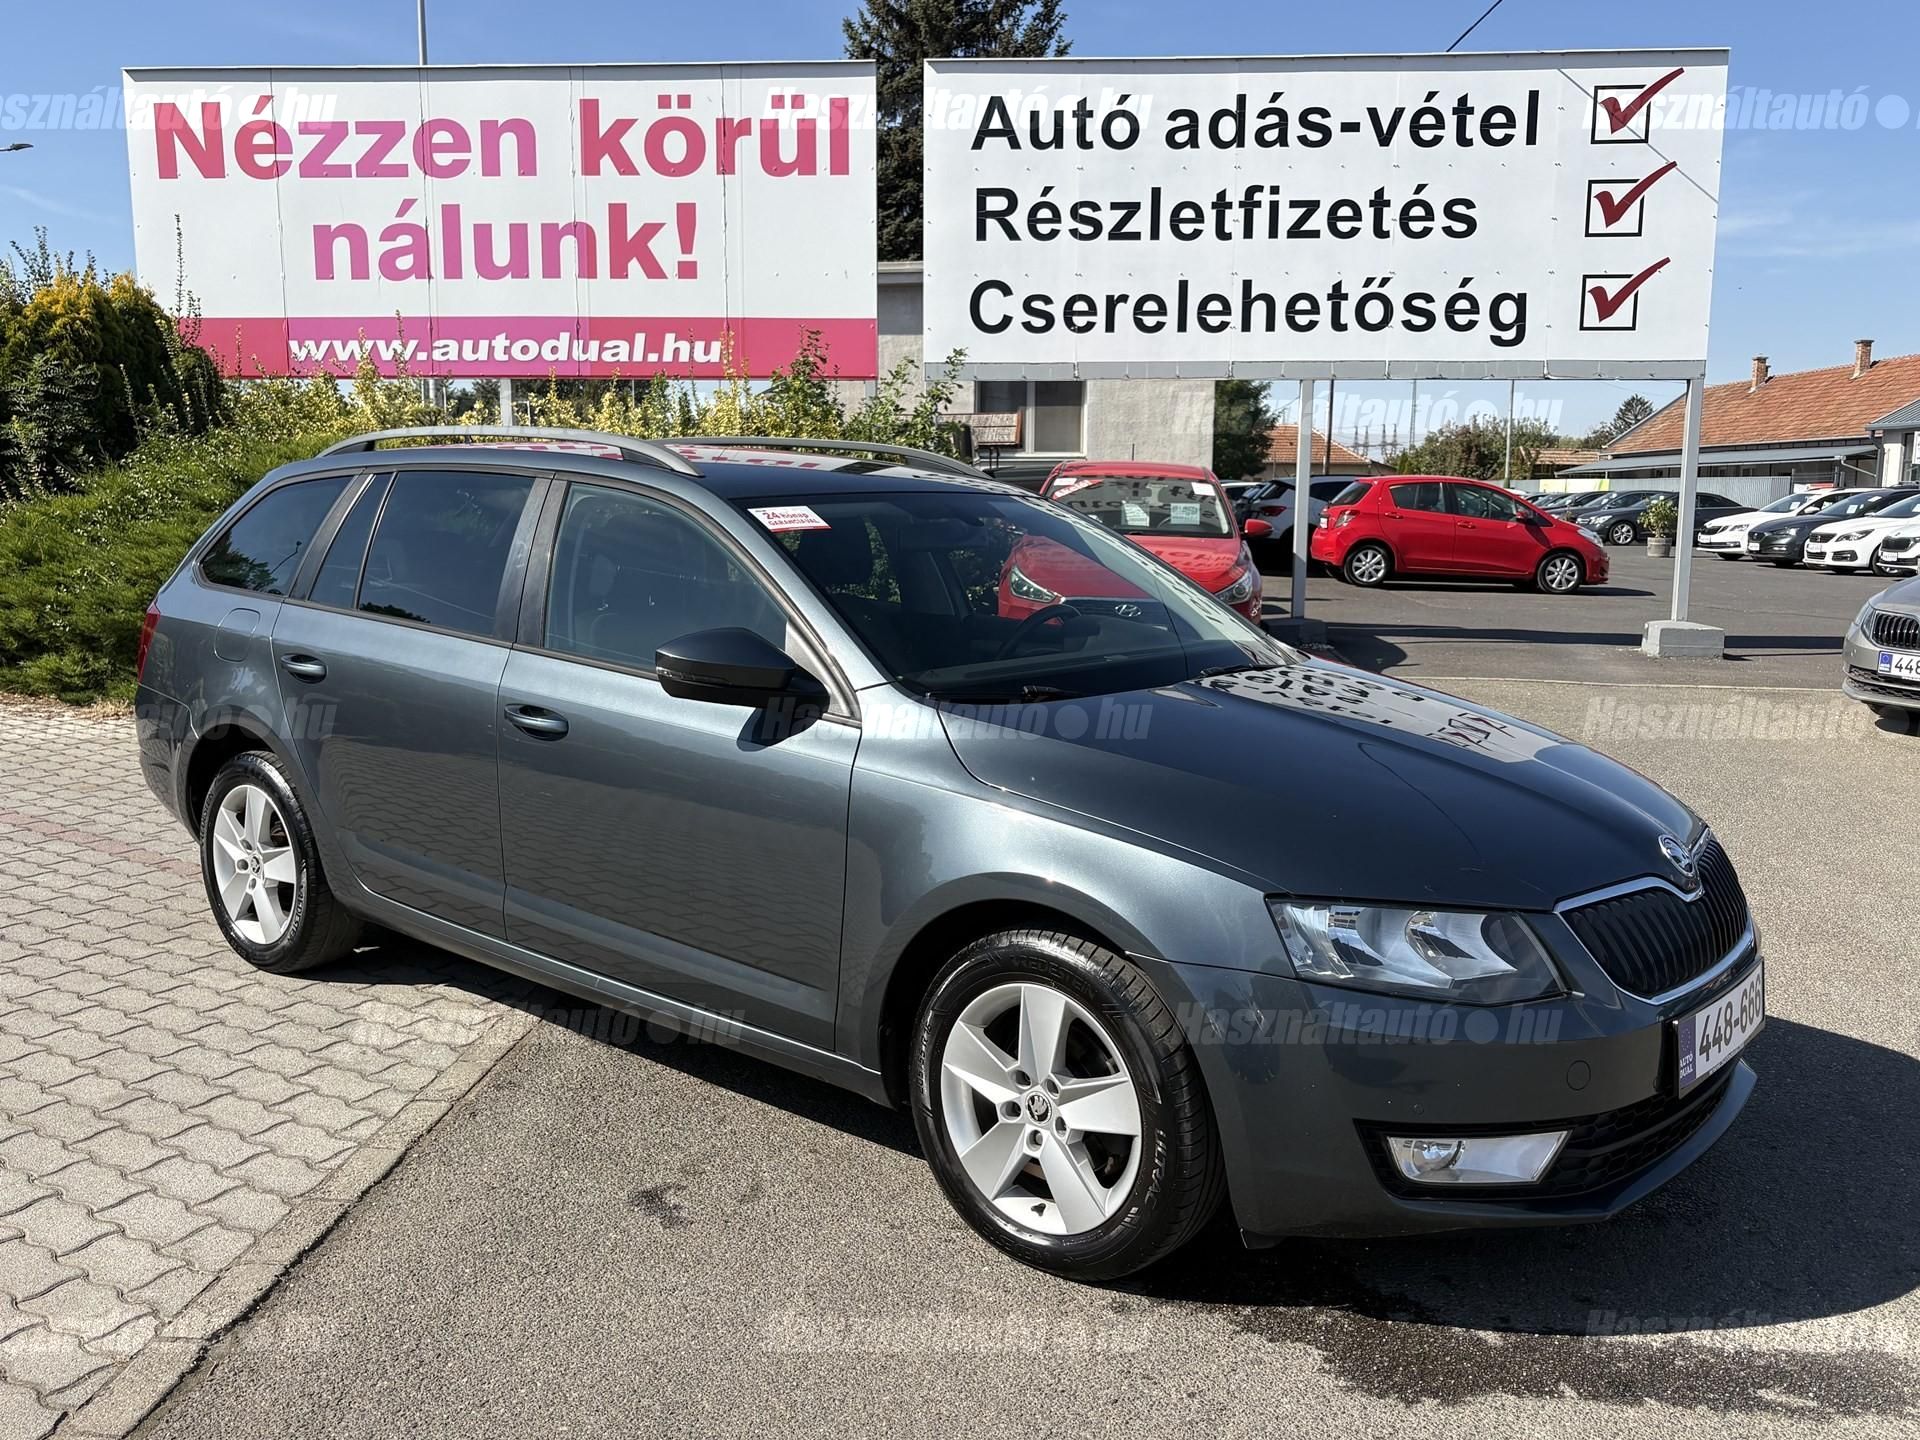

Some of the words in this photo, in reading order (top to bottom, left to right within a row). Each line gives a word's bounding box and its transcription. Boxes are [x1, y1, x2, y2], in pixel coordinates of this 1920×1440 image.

[153, 94, 538, 180] Nézzen
[581, 94, 850, 178] körül
[970, 94, 1139, 150] Autó
[1164, 89, 1540, 150] adás-vétel
[314, 199, 698, 281] nálunk!
[974, 184, 1478, 242] Részletfizetés
[969, 276, 1530, 347] Cserelehetőség
[290, 332, 722, 365] www.autodual.hu
[1699, 974, 1761, 1062] 448-666
